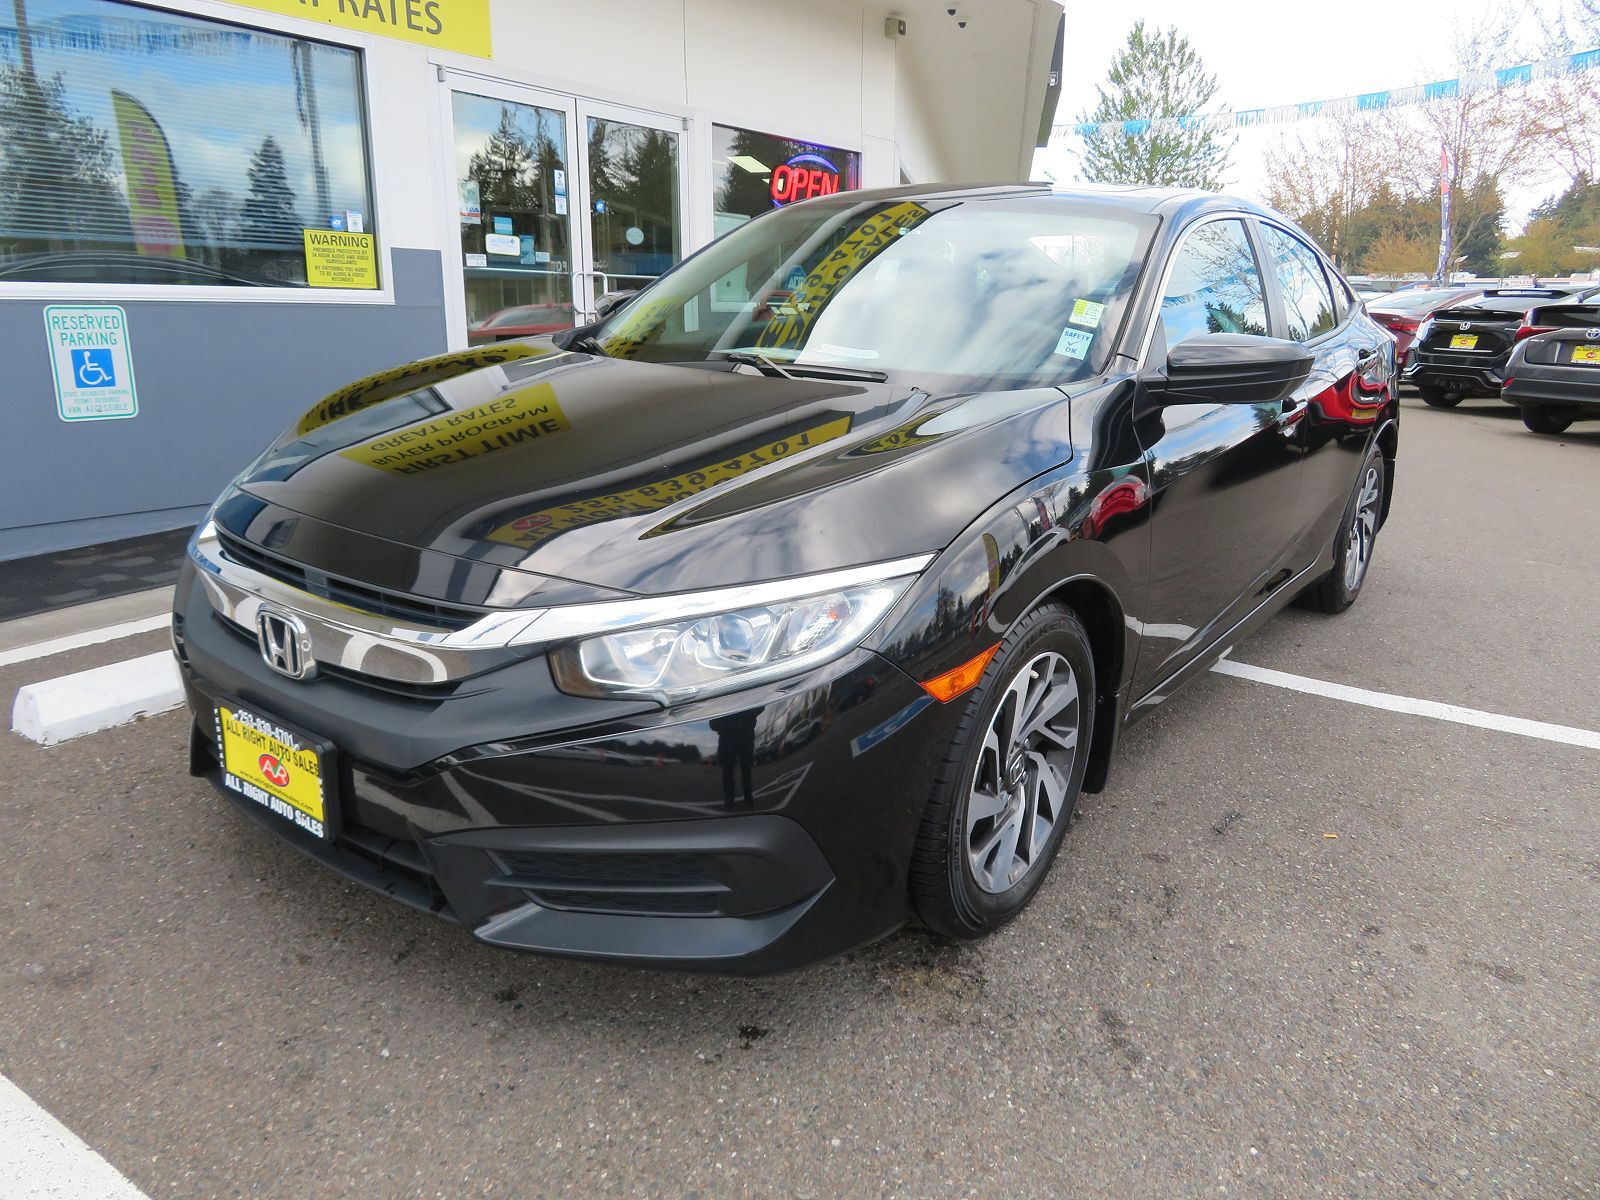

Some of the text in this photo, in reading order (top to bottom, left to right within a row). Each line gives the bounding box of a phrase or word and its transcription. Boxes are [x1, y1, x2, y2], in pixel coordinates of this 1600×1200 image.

[772, 165, 839, 202] OPEN
[309, 233, 369, 248] WARNING
[52, 315, 120, 330] RESERVED
[60, 332, 118, 346] PARKING
[1064, 331, 1090, 341] SAFETY
[1065, 346, 1077, 354] OK
[85, 403, 129, 412] ACCESSIBLE
[226, 718, 319, 777] ALL RIGHT AUTO SALES
[225, 773, 324, 839] ALL RIGHT AUTO SALES
